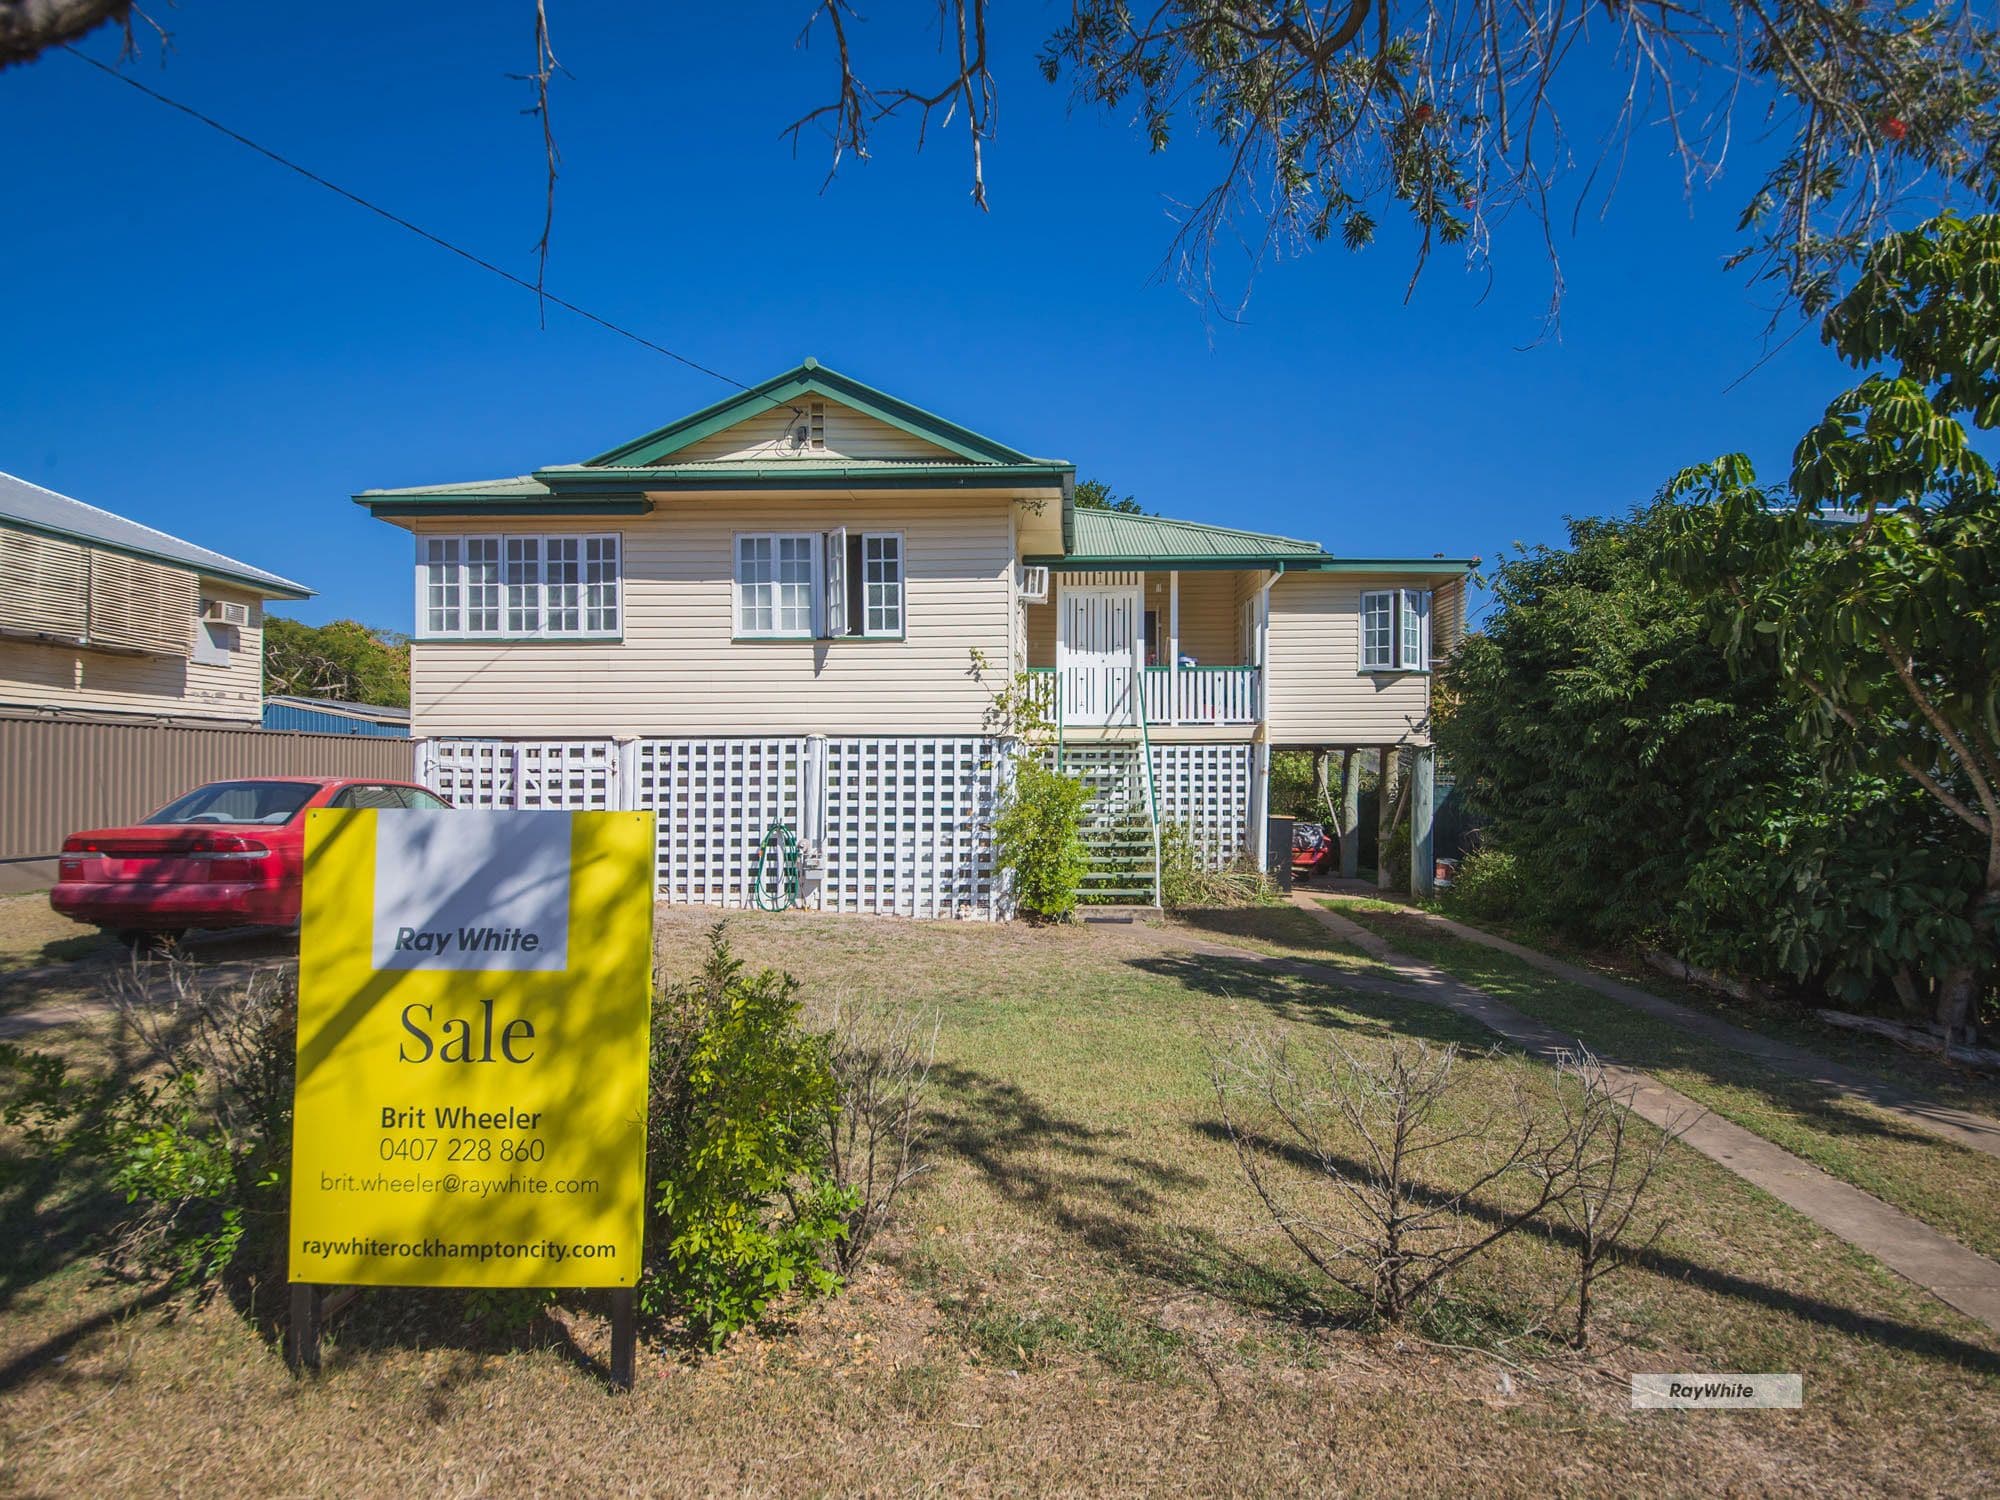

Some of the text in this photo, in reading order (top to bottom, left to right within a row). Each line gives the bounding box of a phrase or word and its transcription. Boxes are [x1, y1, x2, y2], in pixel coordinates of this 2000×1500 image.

[395, 927, 539, 956] Ray White
[399, 999, 535, 1064] Sale
[381, 1106, 542, 1130] Brit Wheeler
[379, 1137, 545, 1162] 0407 228 860
[321, 1171, 600, 1199] brit.wheeler@raywhite.com
[302, 1237, 616, 1262] raywhiterockhamptoncity.com
